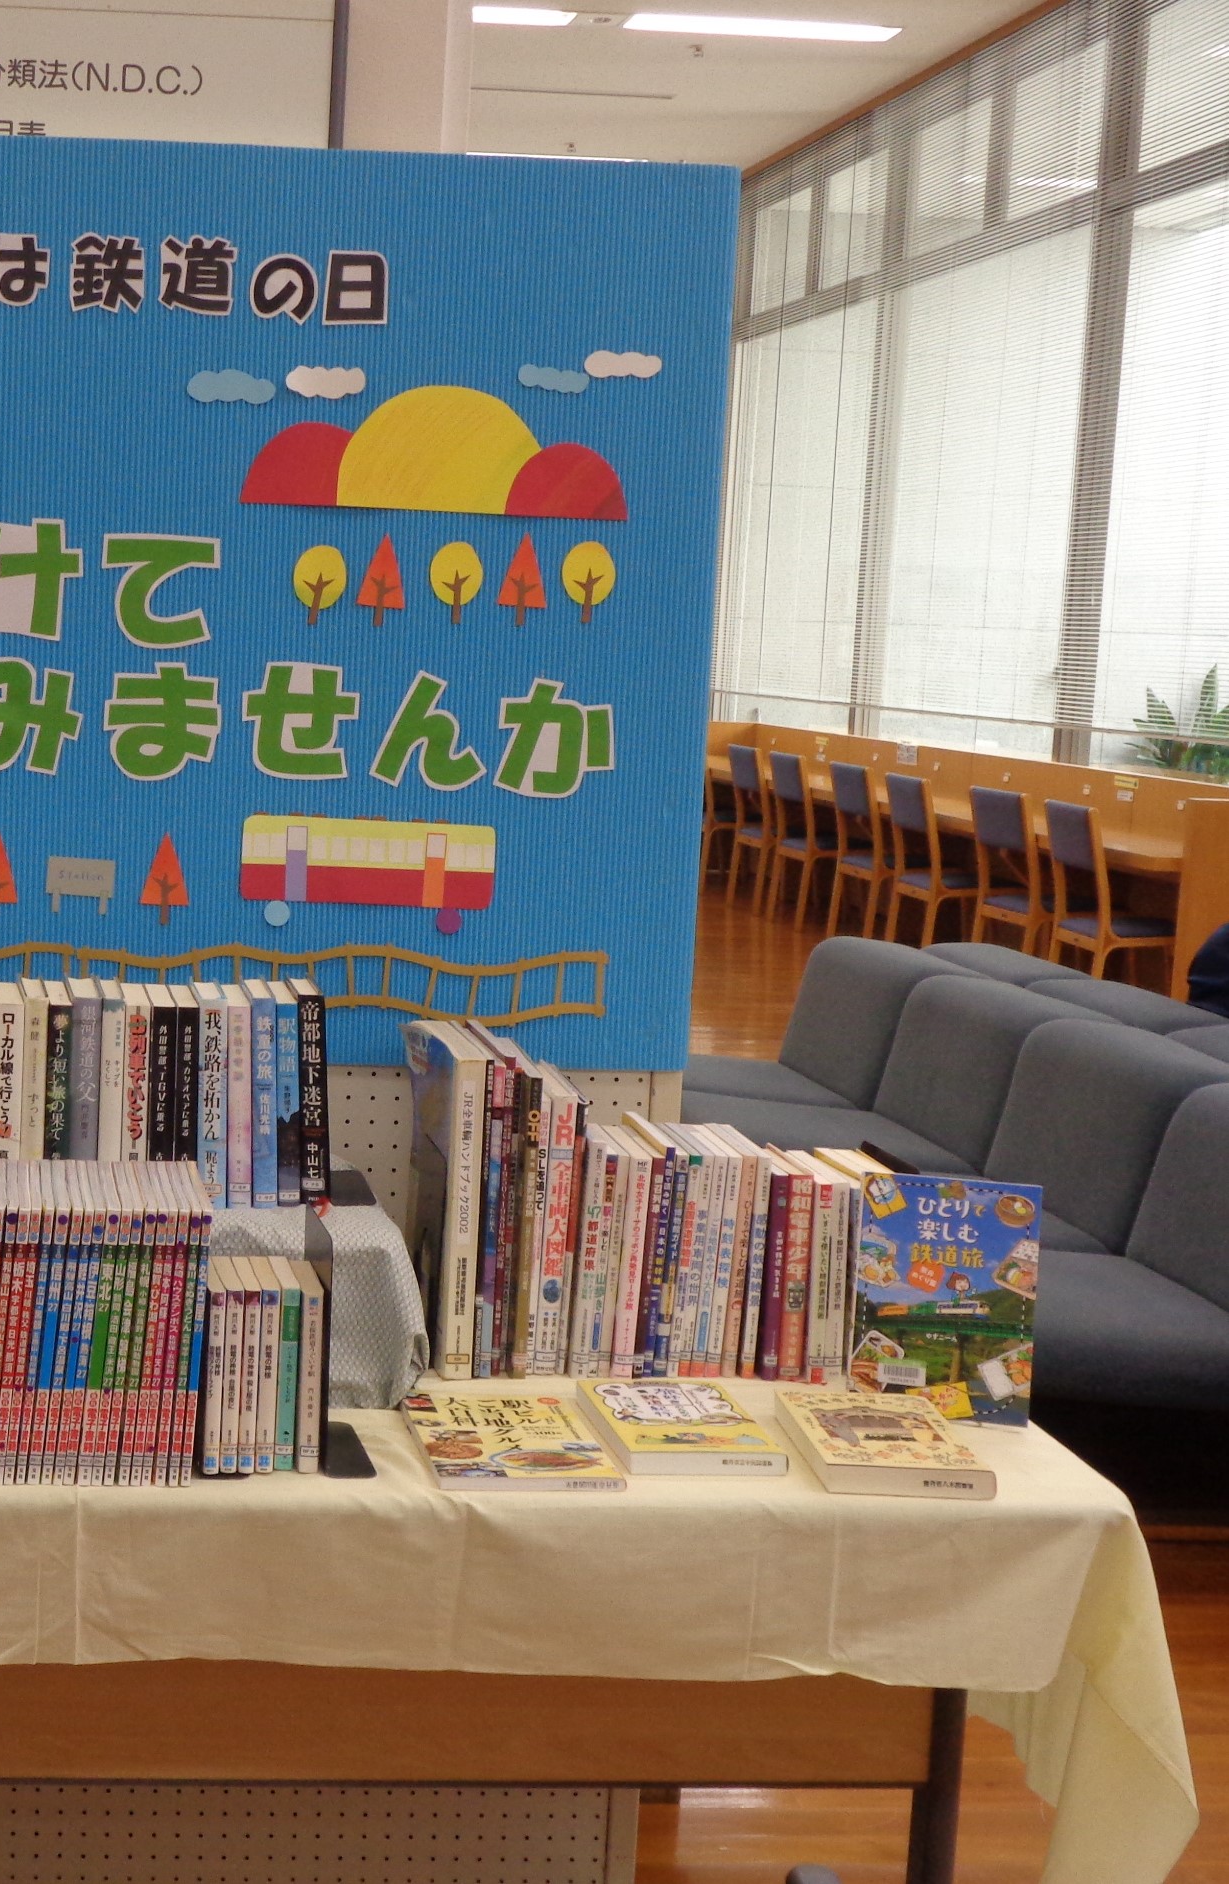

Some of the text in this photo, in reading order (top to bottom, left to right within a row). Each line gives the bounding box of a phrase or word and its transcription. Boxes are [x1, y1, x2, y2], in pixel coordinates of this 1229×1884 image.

[77, 1006, 97, 1102] 銀河鉄道の父
[257, 1015, 272, 1080] 鉄童の旅
[278, 1017, 296, 1072] 駅物語
[0, 1012, 15, 1136] ローカル線で行こう!
[51, 1013, 70, 1141] 夢より短い旅の果て
[156, 1025, 168, 1132] 外田警部、TGVに乗る
[203, 1011, 222, 1141] 我、鉄路を拓かん
[301, 1001, 322, 1179] 帝都地下迷宮 中山七
[527, 1110, 540, 1142] OFF
[543, 1104, 573, 1277] JR 全車両大図鑑
[917, 1196, 987, 1218] ひとりで
[583, 1206, 602, 1271] 47都道府県
[787, 1179, 813, 1279] 昭和電車少年
[917, 1218, 979, 1244] 楽しむ
[688, 1209, 709, 1306] 事業用車両の世界
[717, 1218, 735, 1289] 時刻表探検
[749, 1214, 767, 1307] 感動の鉄道絶景
[909, 1242, 985, 1269] 鉄道旅
[0, 1260, 11, 1295] 和歌山
[10, 1260, 24, 1293] 栃木
[24, 1260, 35, 1288] 埼玉
[48, 1261, 63, 1312] 信州 27
[98, 1262, 114, 1312] 東北 27
[113, 1262, 126, 1291] 山形
[595, 1272, 607, 1311] 山歩き
[168, 1279, 183, 1332] ハウステンボス
[925, 1332, 958, 1343] やすこーん
[77, 1369, 86, 1379] 27
[264, 1344, 272, 1379] 終電の神様
[3, 1375, 12, 1385] 27
[14, 1375, 24, 1385] 27
[53, 1376, 63, 1386] 27
[103, 1377, 112, 1386] 27
[115, 1376, 124, 1386] 27
[129, 1377, 138, 1387] 27
[141, 1376, 150, 1386] 27
[151, 1377, 161, 1386] 27
[164, 1376, 173, 1386] 27
[177, 1376, 187, 1386] 27
[446, 1396, 480, 1427] 大百科
[477, 1399, 523, 1451] ご当地グルメ
